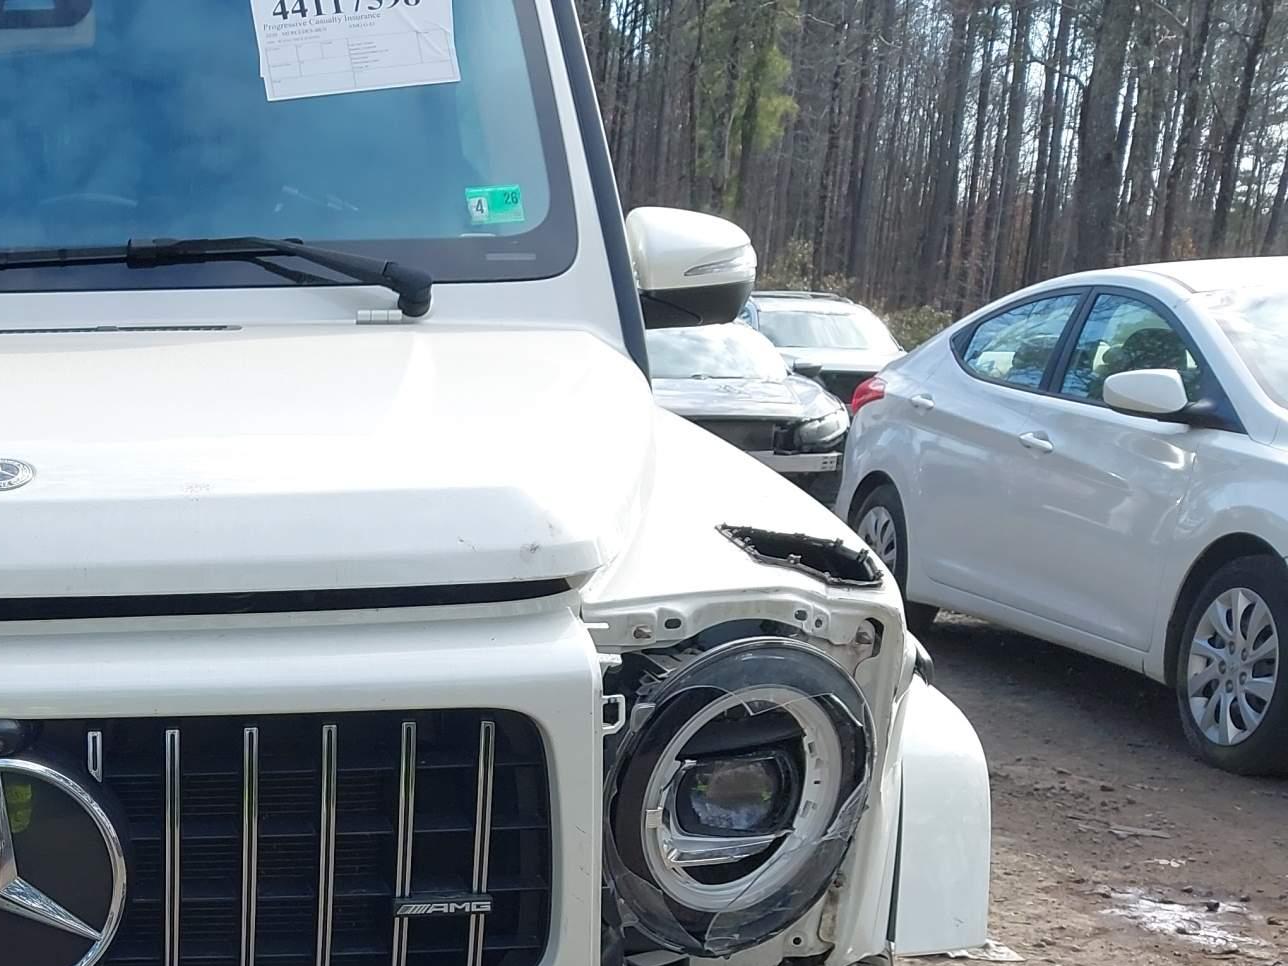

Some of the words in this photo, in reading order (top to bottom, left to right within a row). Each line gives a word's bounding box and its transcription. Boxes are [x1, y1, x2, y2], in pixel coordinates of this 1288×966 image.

[272, 0, 421, 20] 4411
[263, 19, 307, 31] Progressive
[309, 15, 342, 26] Casualty
[344, 12, 381, 22] Insurance
[475, 199, 484, 214] 4
[426, 901, 491, 914] AMG
